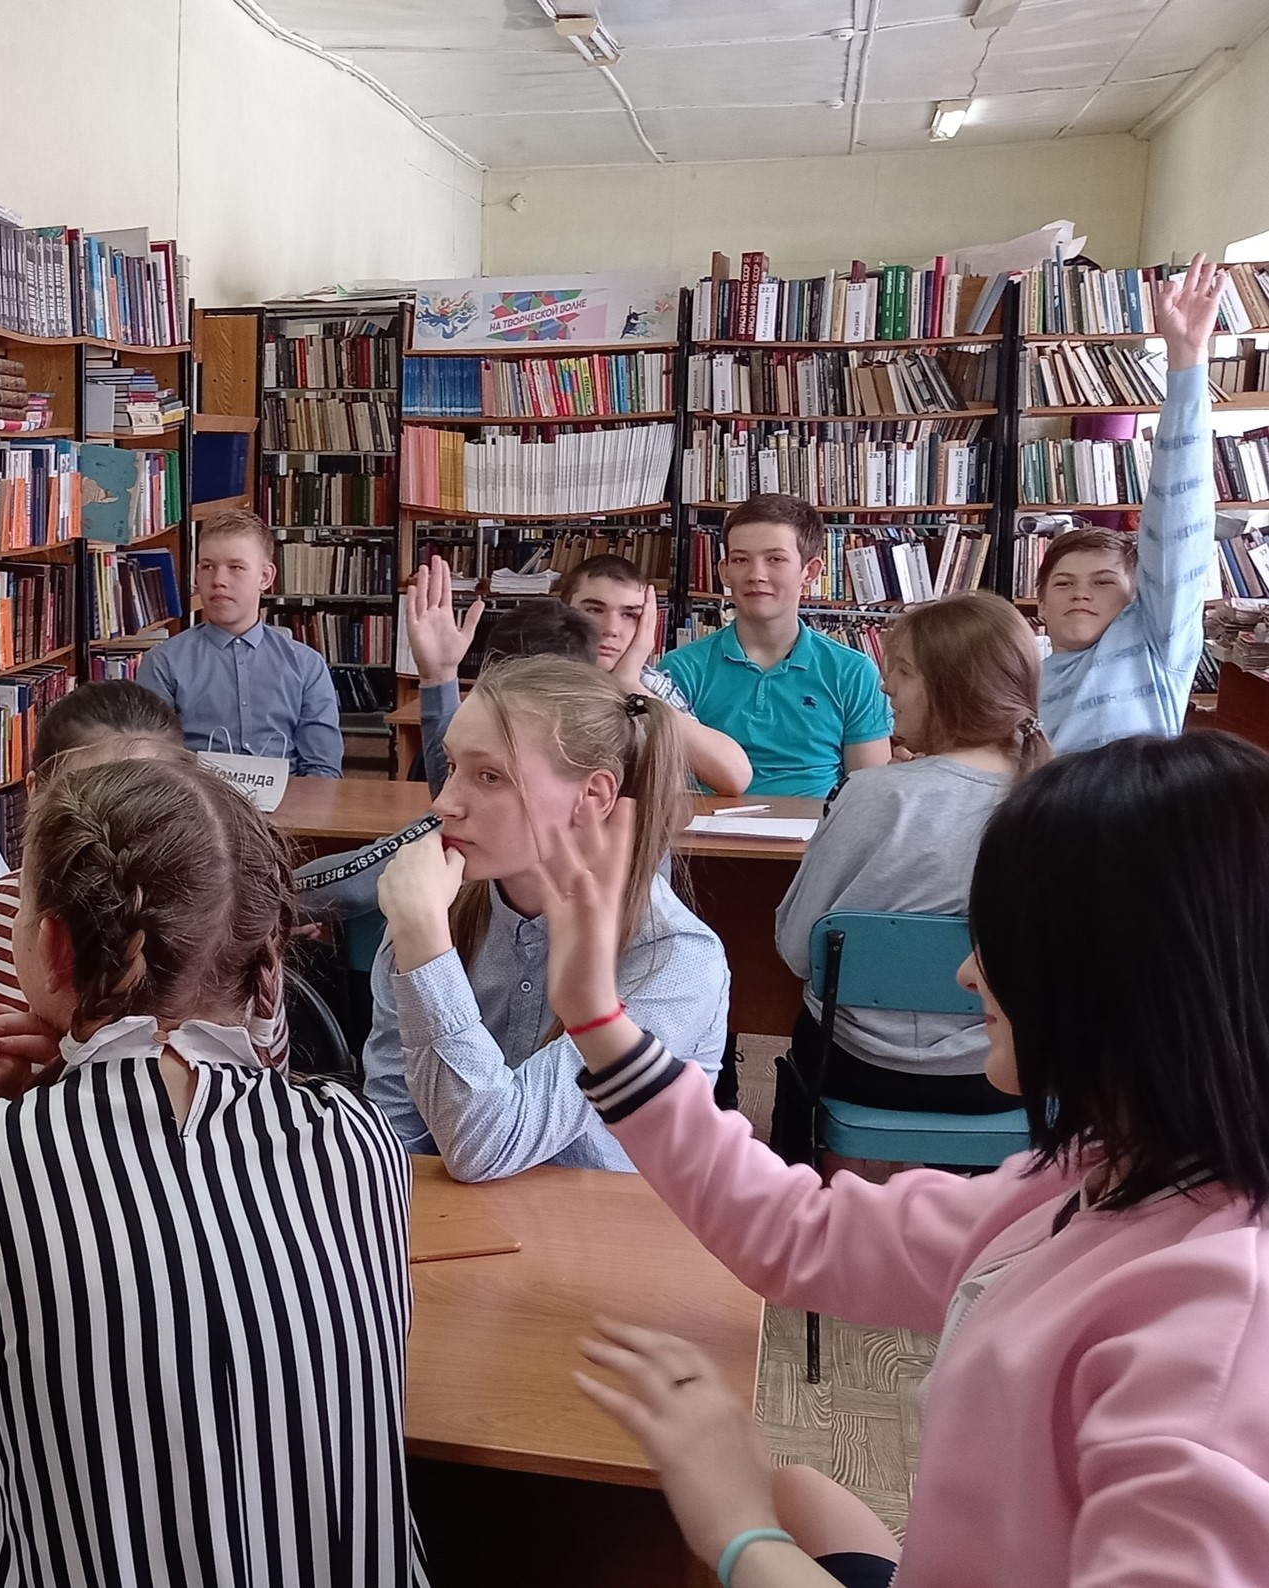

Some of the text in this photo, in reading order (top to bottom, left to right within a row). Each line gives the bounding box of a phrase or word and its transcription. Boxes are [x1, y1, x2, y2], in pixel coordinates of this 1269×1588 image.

[743, 264, 751, 281] СССР
[752, 264, 760, 281] СССР
[489, 298, 587, 332] НА ТВОРЧЕСКОЙ ВОЛНЕ
[874, 472, 882, 503] Ботаника
[955, 461, 964, 498] Энергетика
[398, 820, 432, 845] BEST
[319, 868, 345, 885] BEST
